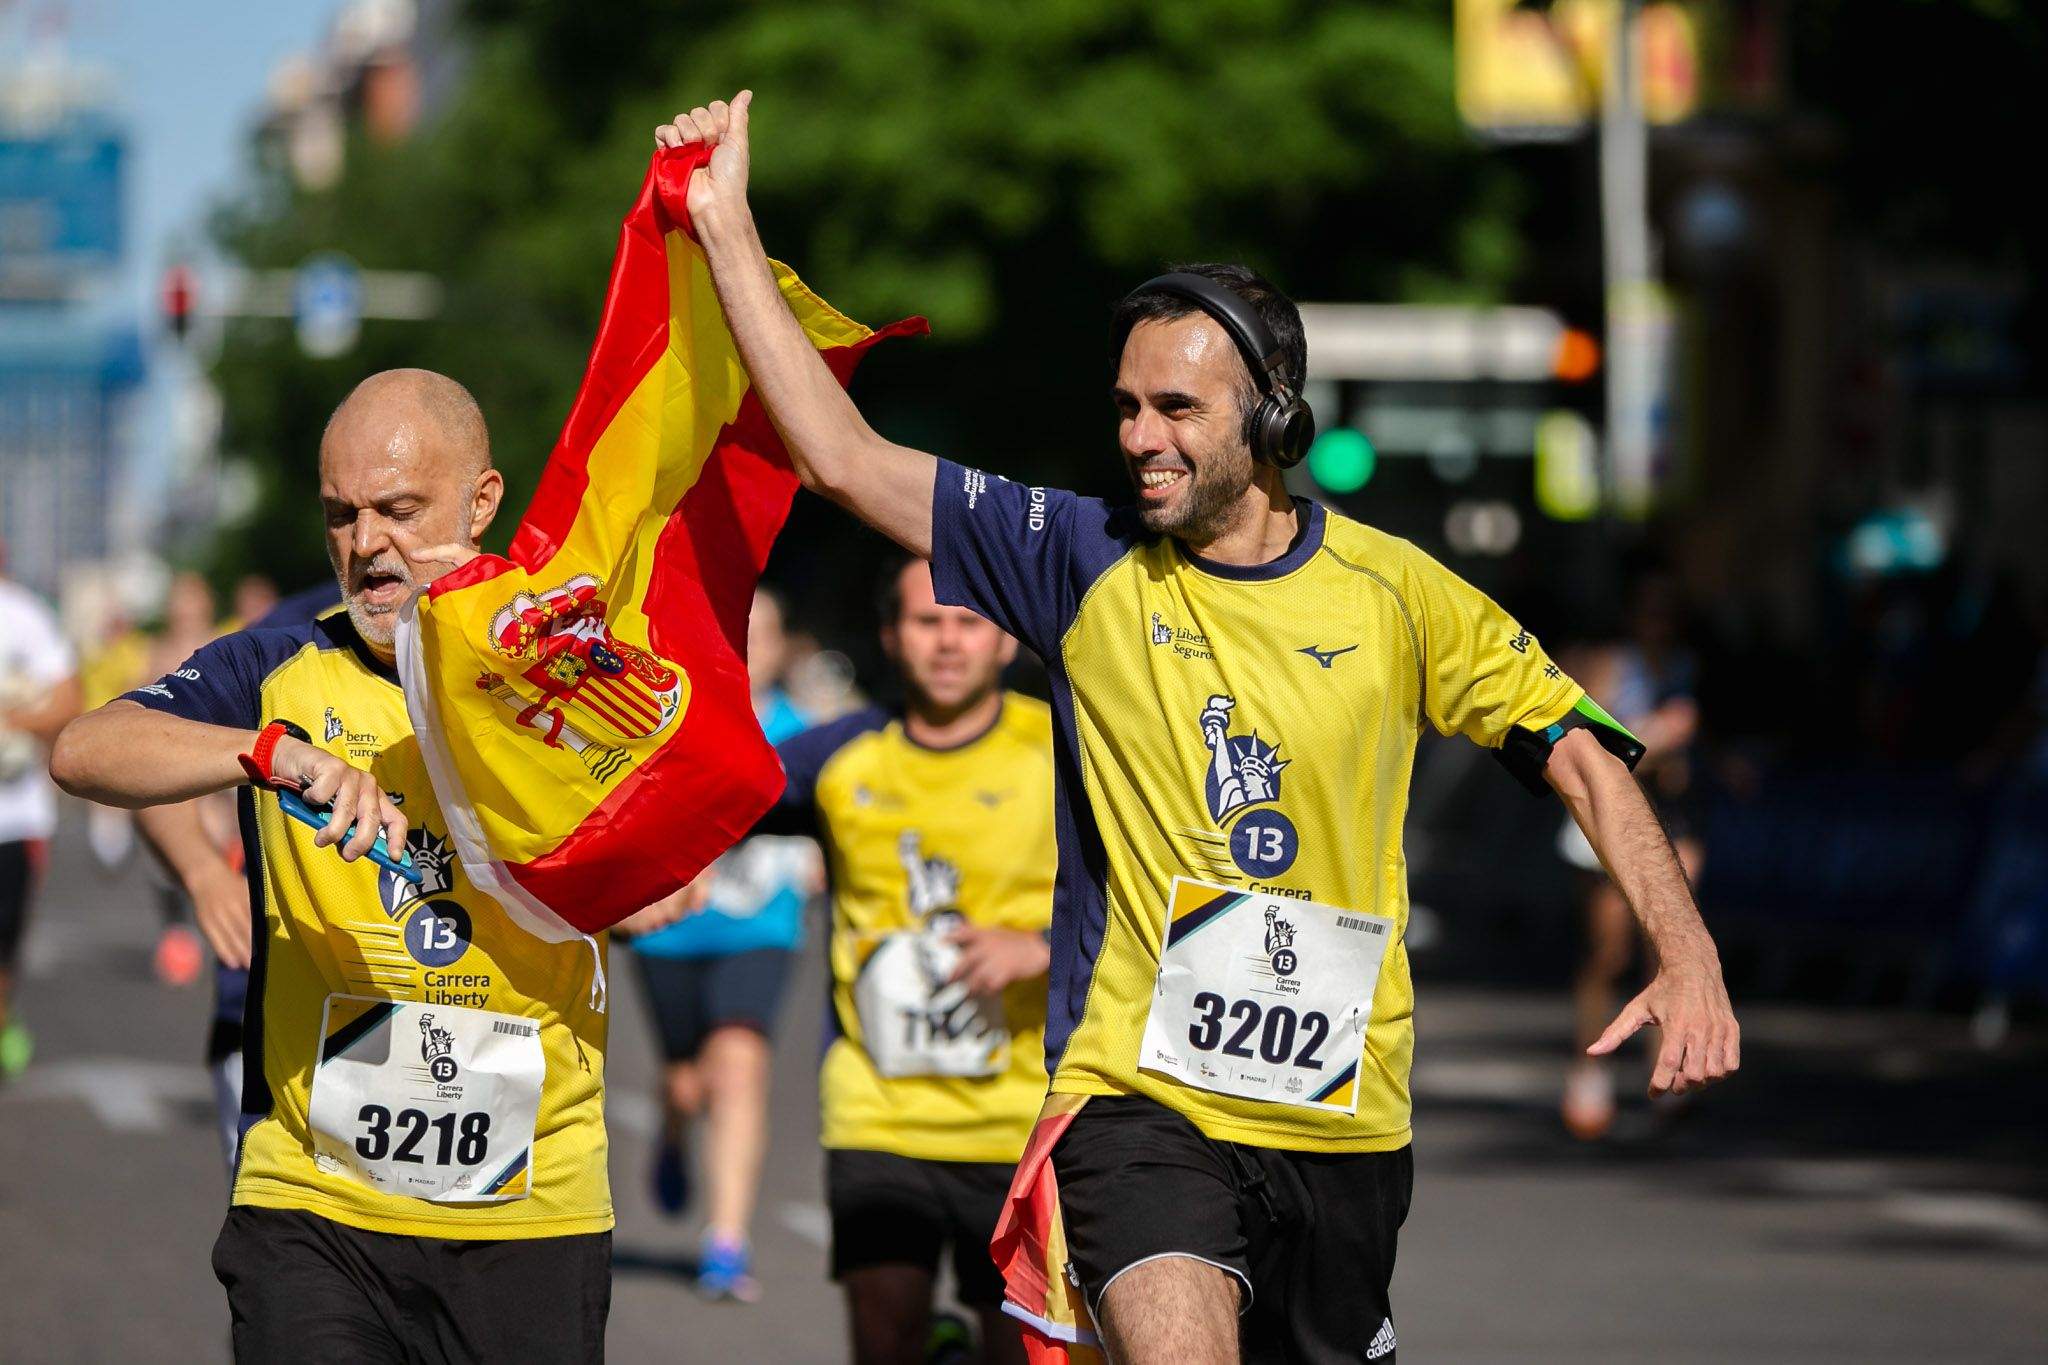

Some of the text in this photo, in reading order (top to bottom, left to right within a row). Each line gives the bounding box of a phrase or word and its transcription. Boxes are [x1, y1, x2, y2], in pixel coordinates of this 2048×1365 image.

[1029, 487, 1045, 531] DRID
[1245, 826, 1284, 863] 13
[420, 917, 458, 950] 13
[1277, 954, 1293, 970] 13
[424, 971, 490, 988] Carrera
[1276, 976, 1301, 987] Carrera
[1275, 983, 1300, 995] Liberty
[425, 990, 490, 1008] Liberty
[1189, 991, 1330, 1071] 3202
[436, 1061, 453, 1077] 13
[436, 1090, 463, 1100] Liberty
[437, 1083, 463, 1092] Carrera
[355, 1104, 491, 1166] 3218
